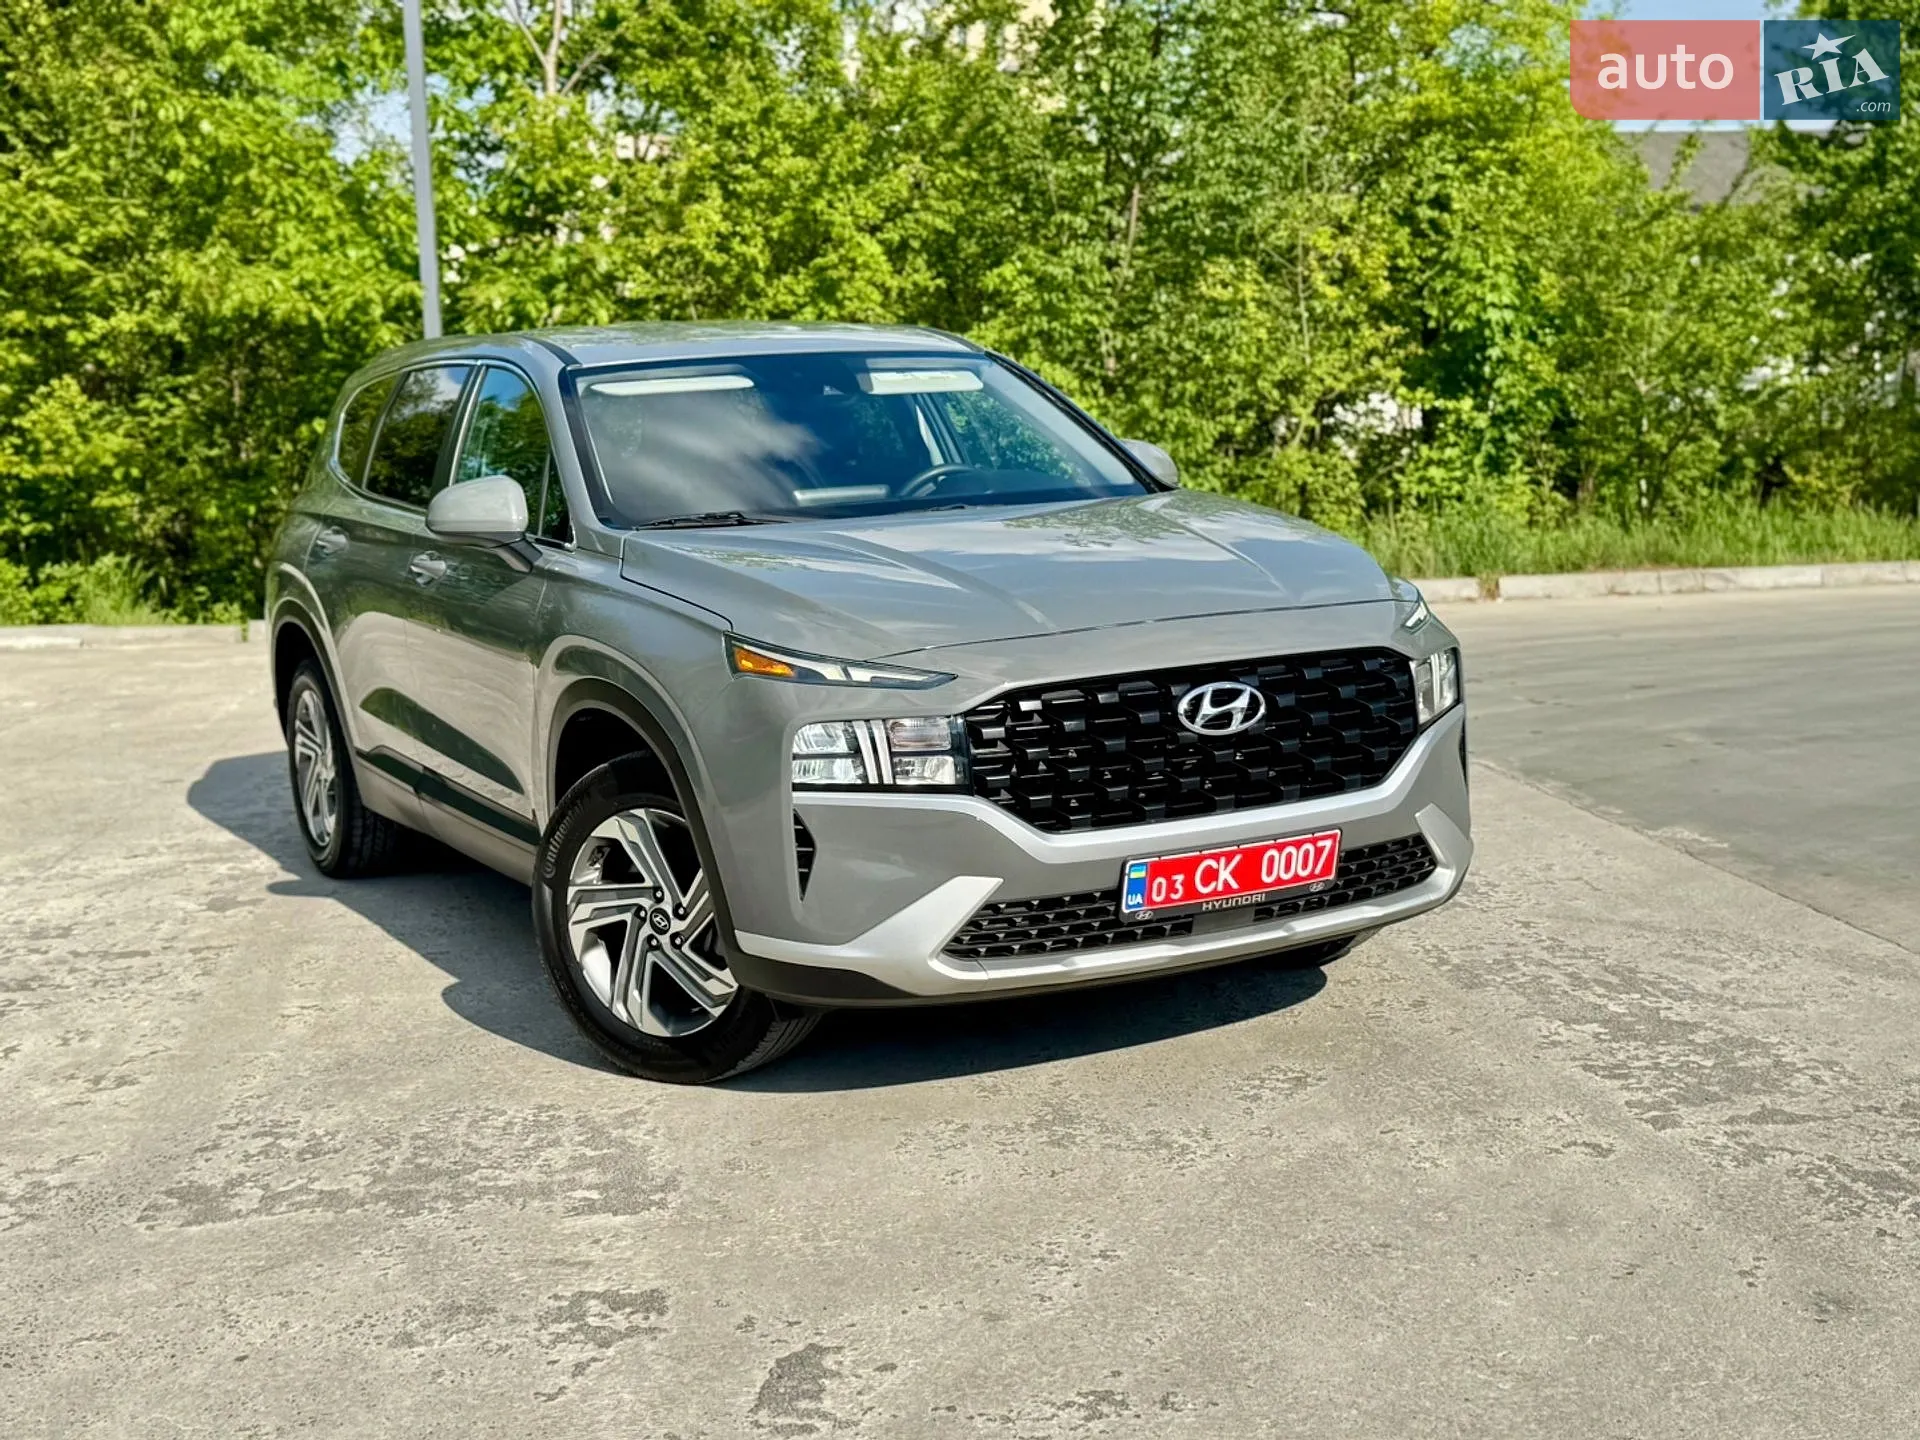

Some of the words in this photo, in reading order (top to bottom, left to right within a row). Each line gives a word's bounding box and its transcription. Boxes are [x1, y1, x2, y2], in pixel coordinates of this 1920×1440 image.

[1151, 874, 1185, 903] 03
[1194, 854, 1242, 894] CK
[1261, 839, 1333, 884] 0007
[1127, 893, 1144, 906] UA
[1202, 893, 1267, 911] HYUNDAI
